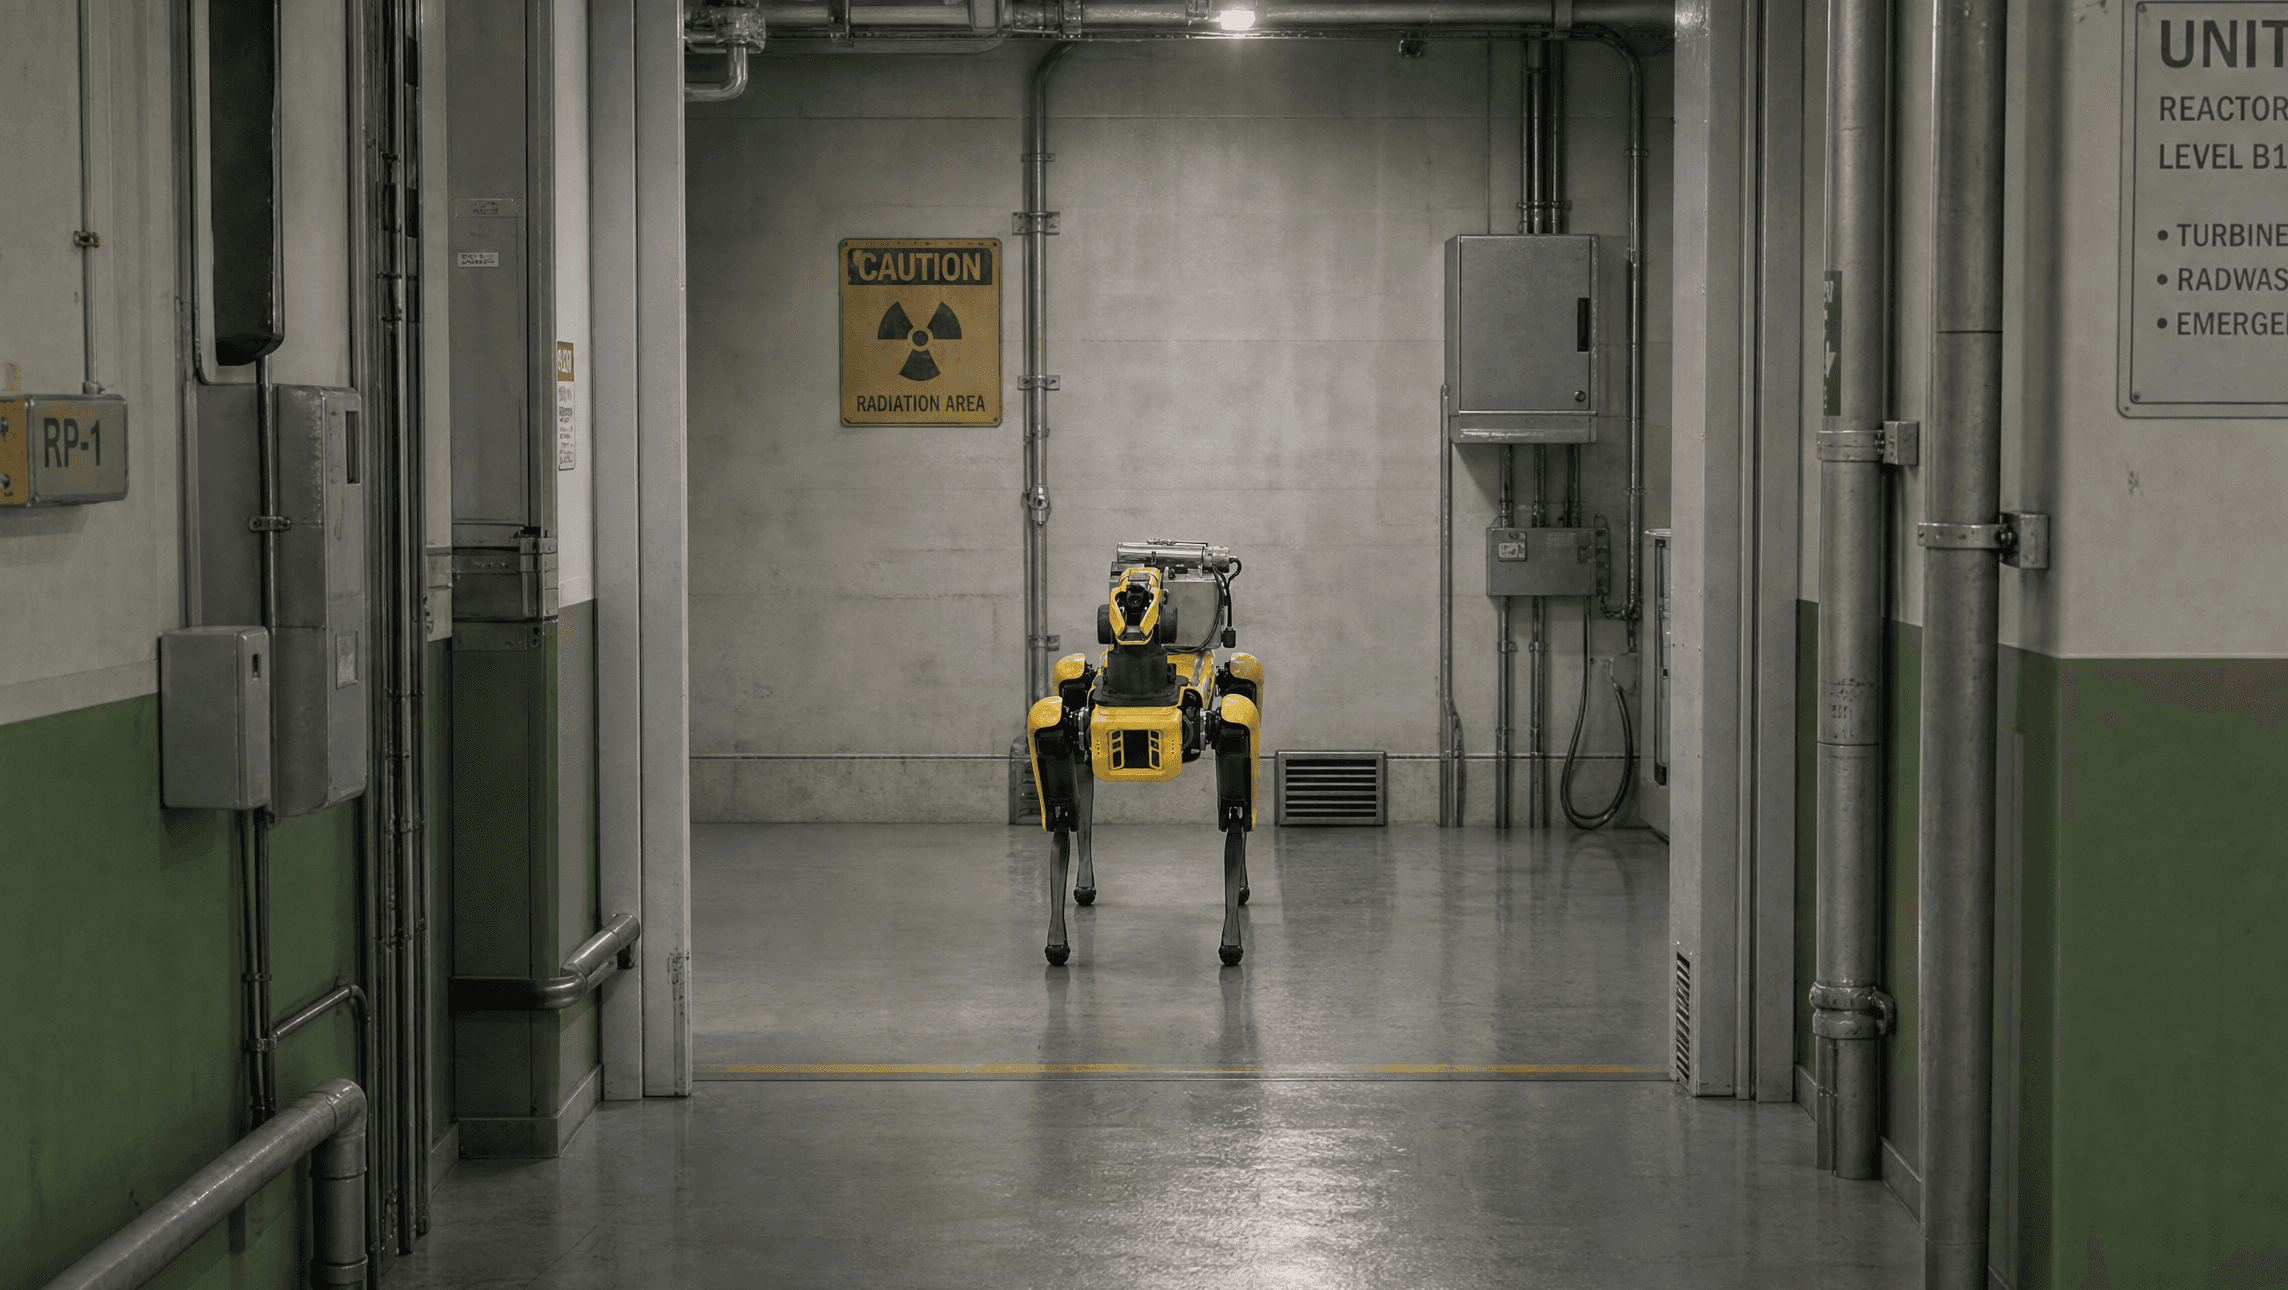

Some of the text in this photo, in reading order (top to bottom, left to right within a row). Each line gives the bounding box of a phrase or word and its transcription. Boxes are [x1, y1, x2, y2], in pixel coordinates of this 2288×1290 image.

[2159, 19, 2288, 68] UNIT
[2160, 95, 2288, 121] REACTOR
[2159, 143, 2288, 169] LEVEL B1
[2176, 223, 2288, 247] TURBINE
[858, 252, 981, 281] CAUTION
[2178, 267, 2288, 291] RADWAS
[2177, 311, 2288, 336] EMERGE
[857, 395, 986, 412] RADIATION AREA
[43, 417, 101, 468] RP-1
